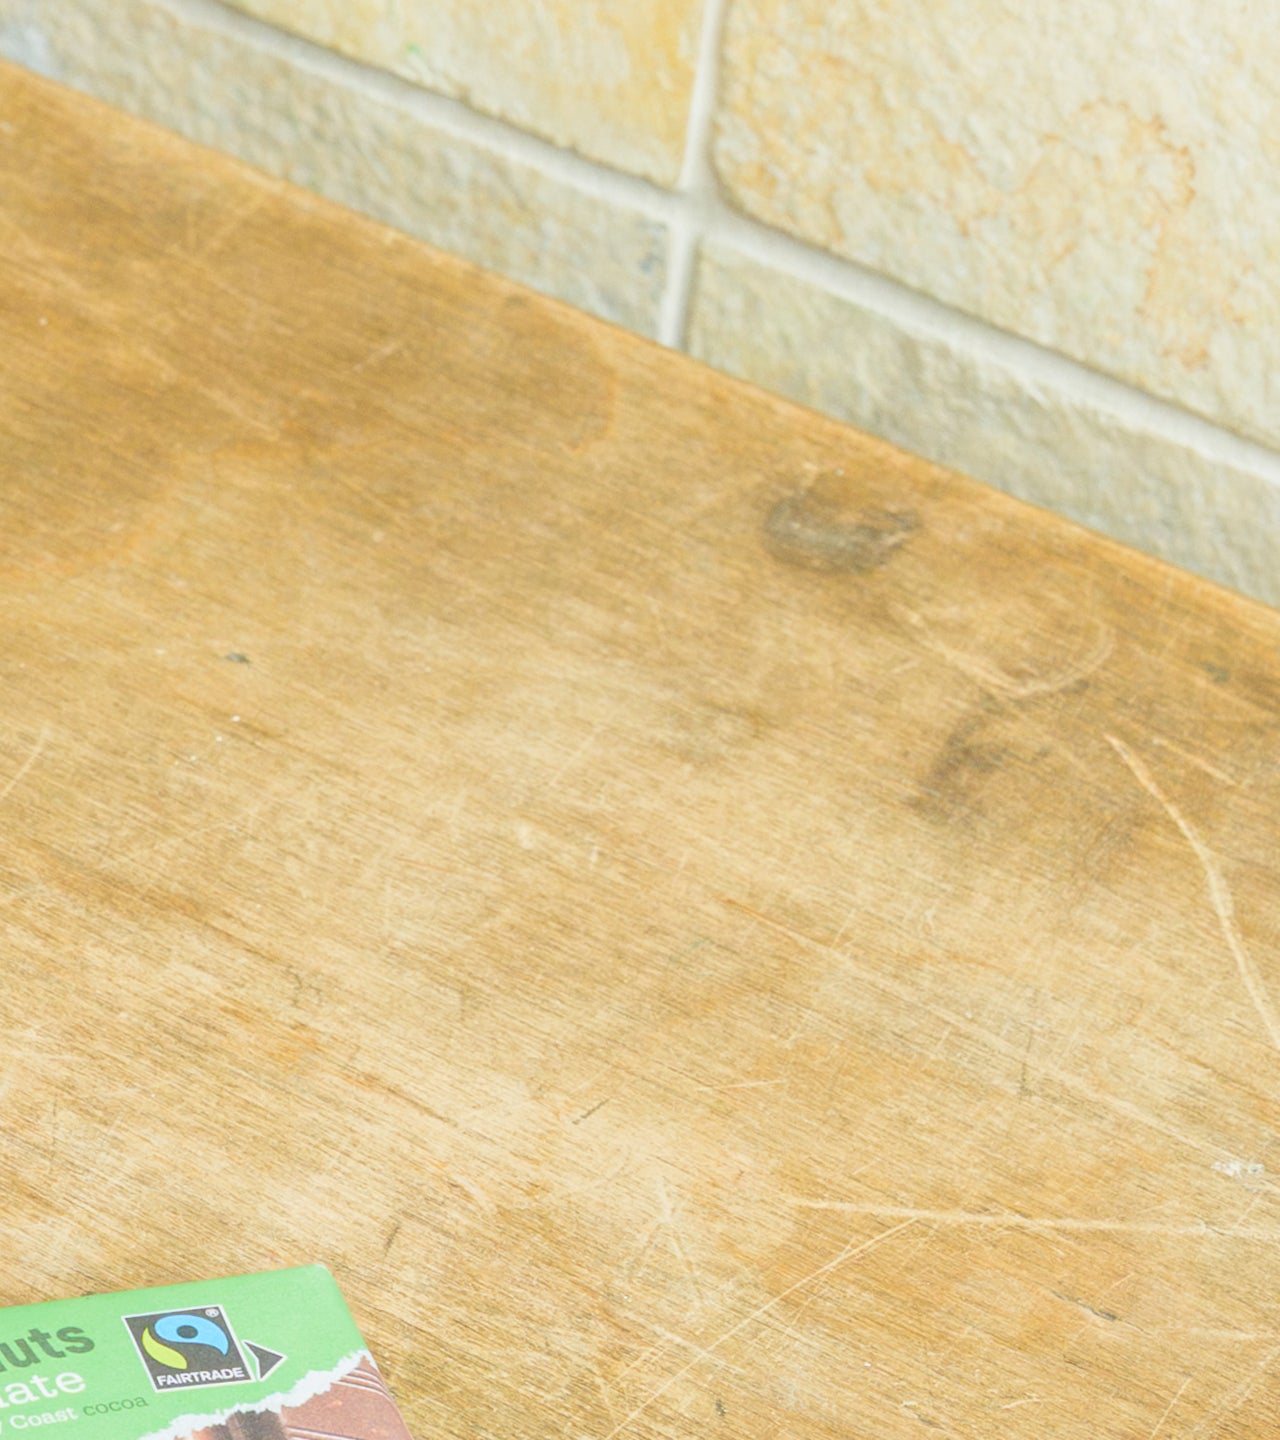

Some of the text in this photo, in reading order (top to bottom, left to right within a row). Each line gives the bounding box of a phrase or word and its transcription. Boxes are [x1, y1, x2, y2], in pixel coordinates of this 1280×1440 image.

[156, 1366, 245, 1388] FAIRTRADE
[10, 1406, 78, 1430] Coast
[82, 1394, 149, 1418] cocoa
